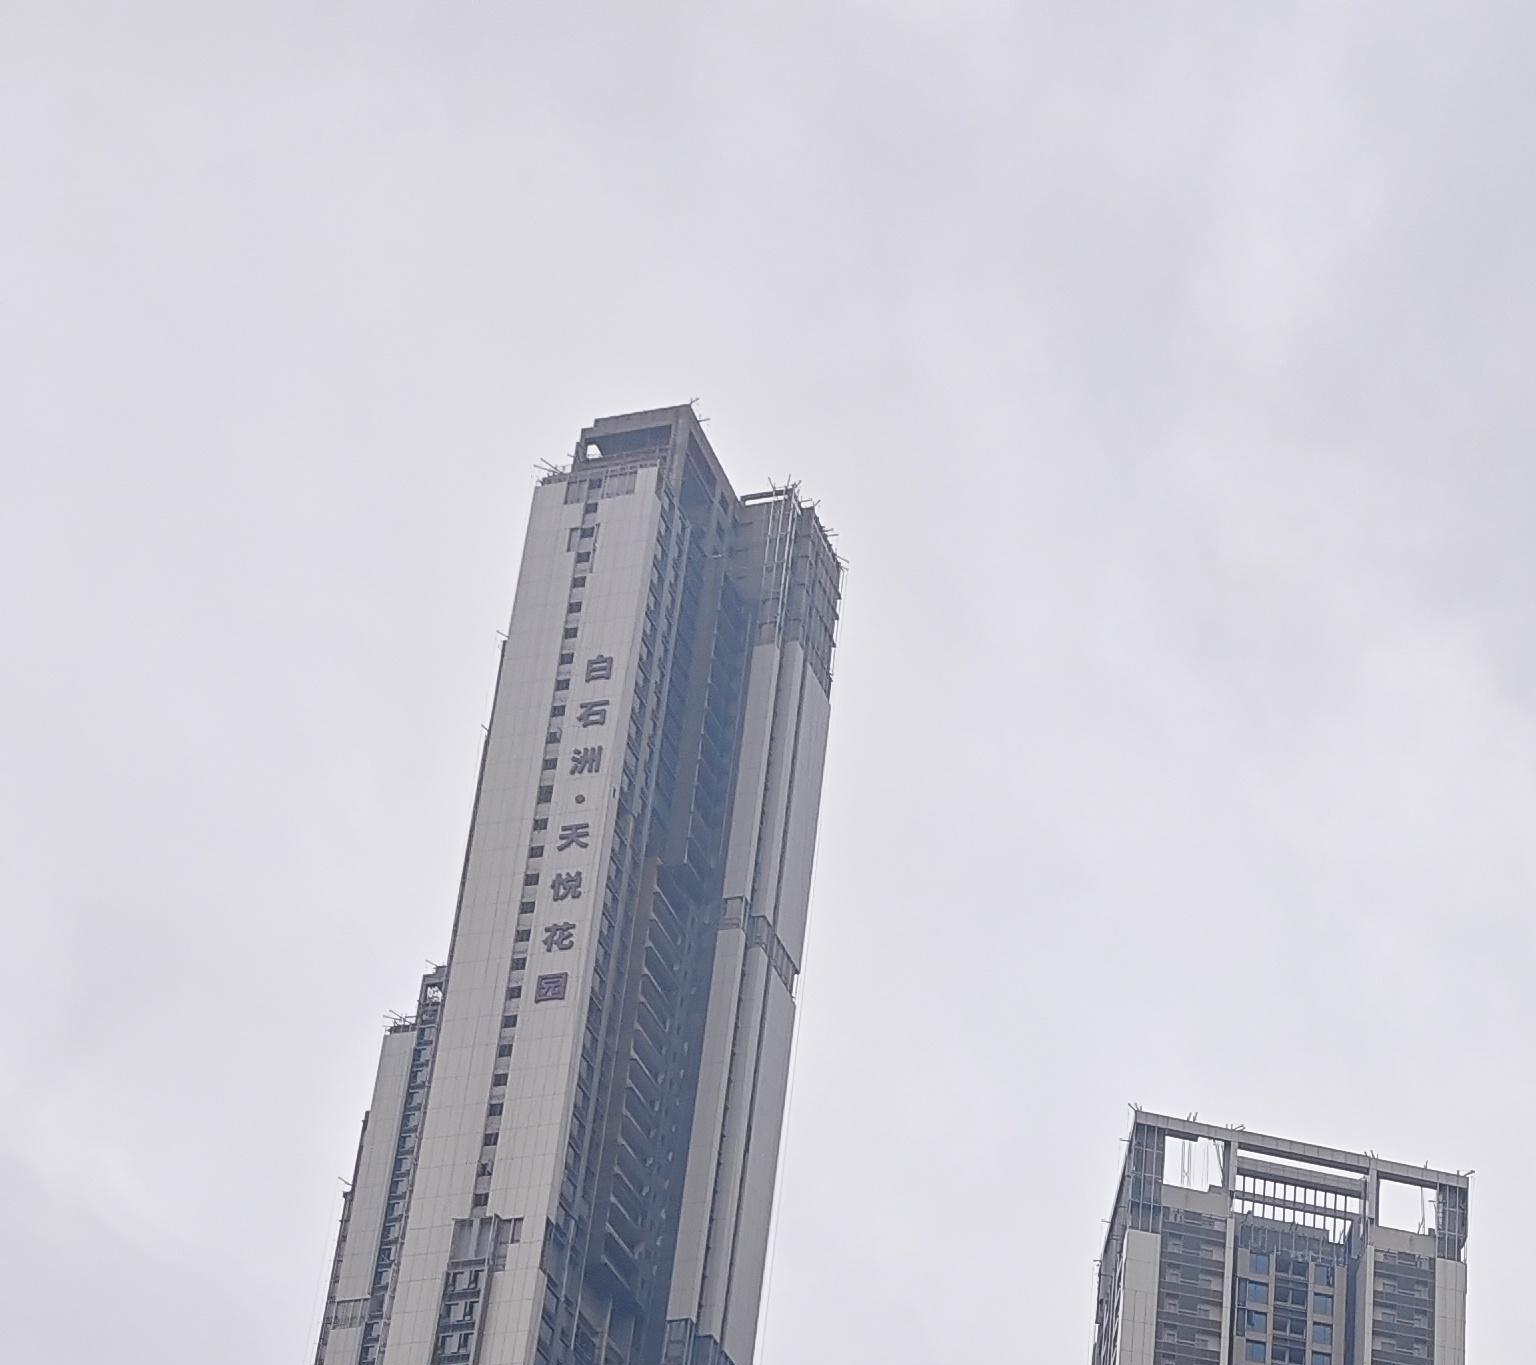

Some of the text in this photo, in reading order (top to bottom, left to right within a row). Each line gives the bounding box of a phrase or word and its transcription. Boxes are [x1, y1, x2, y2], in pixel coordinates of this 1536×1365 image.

[534, 654, 613, 1003] 白石洲·天悦花园
